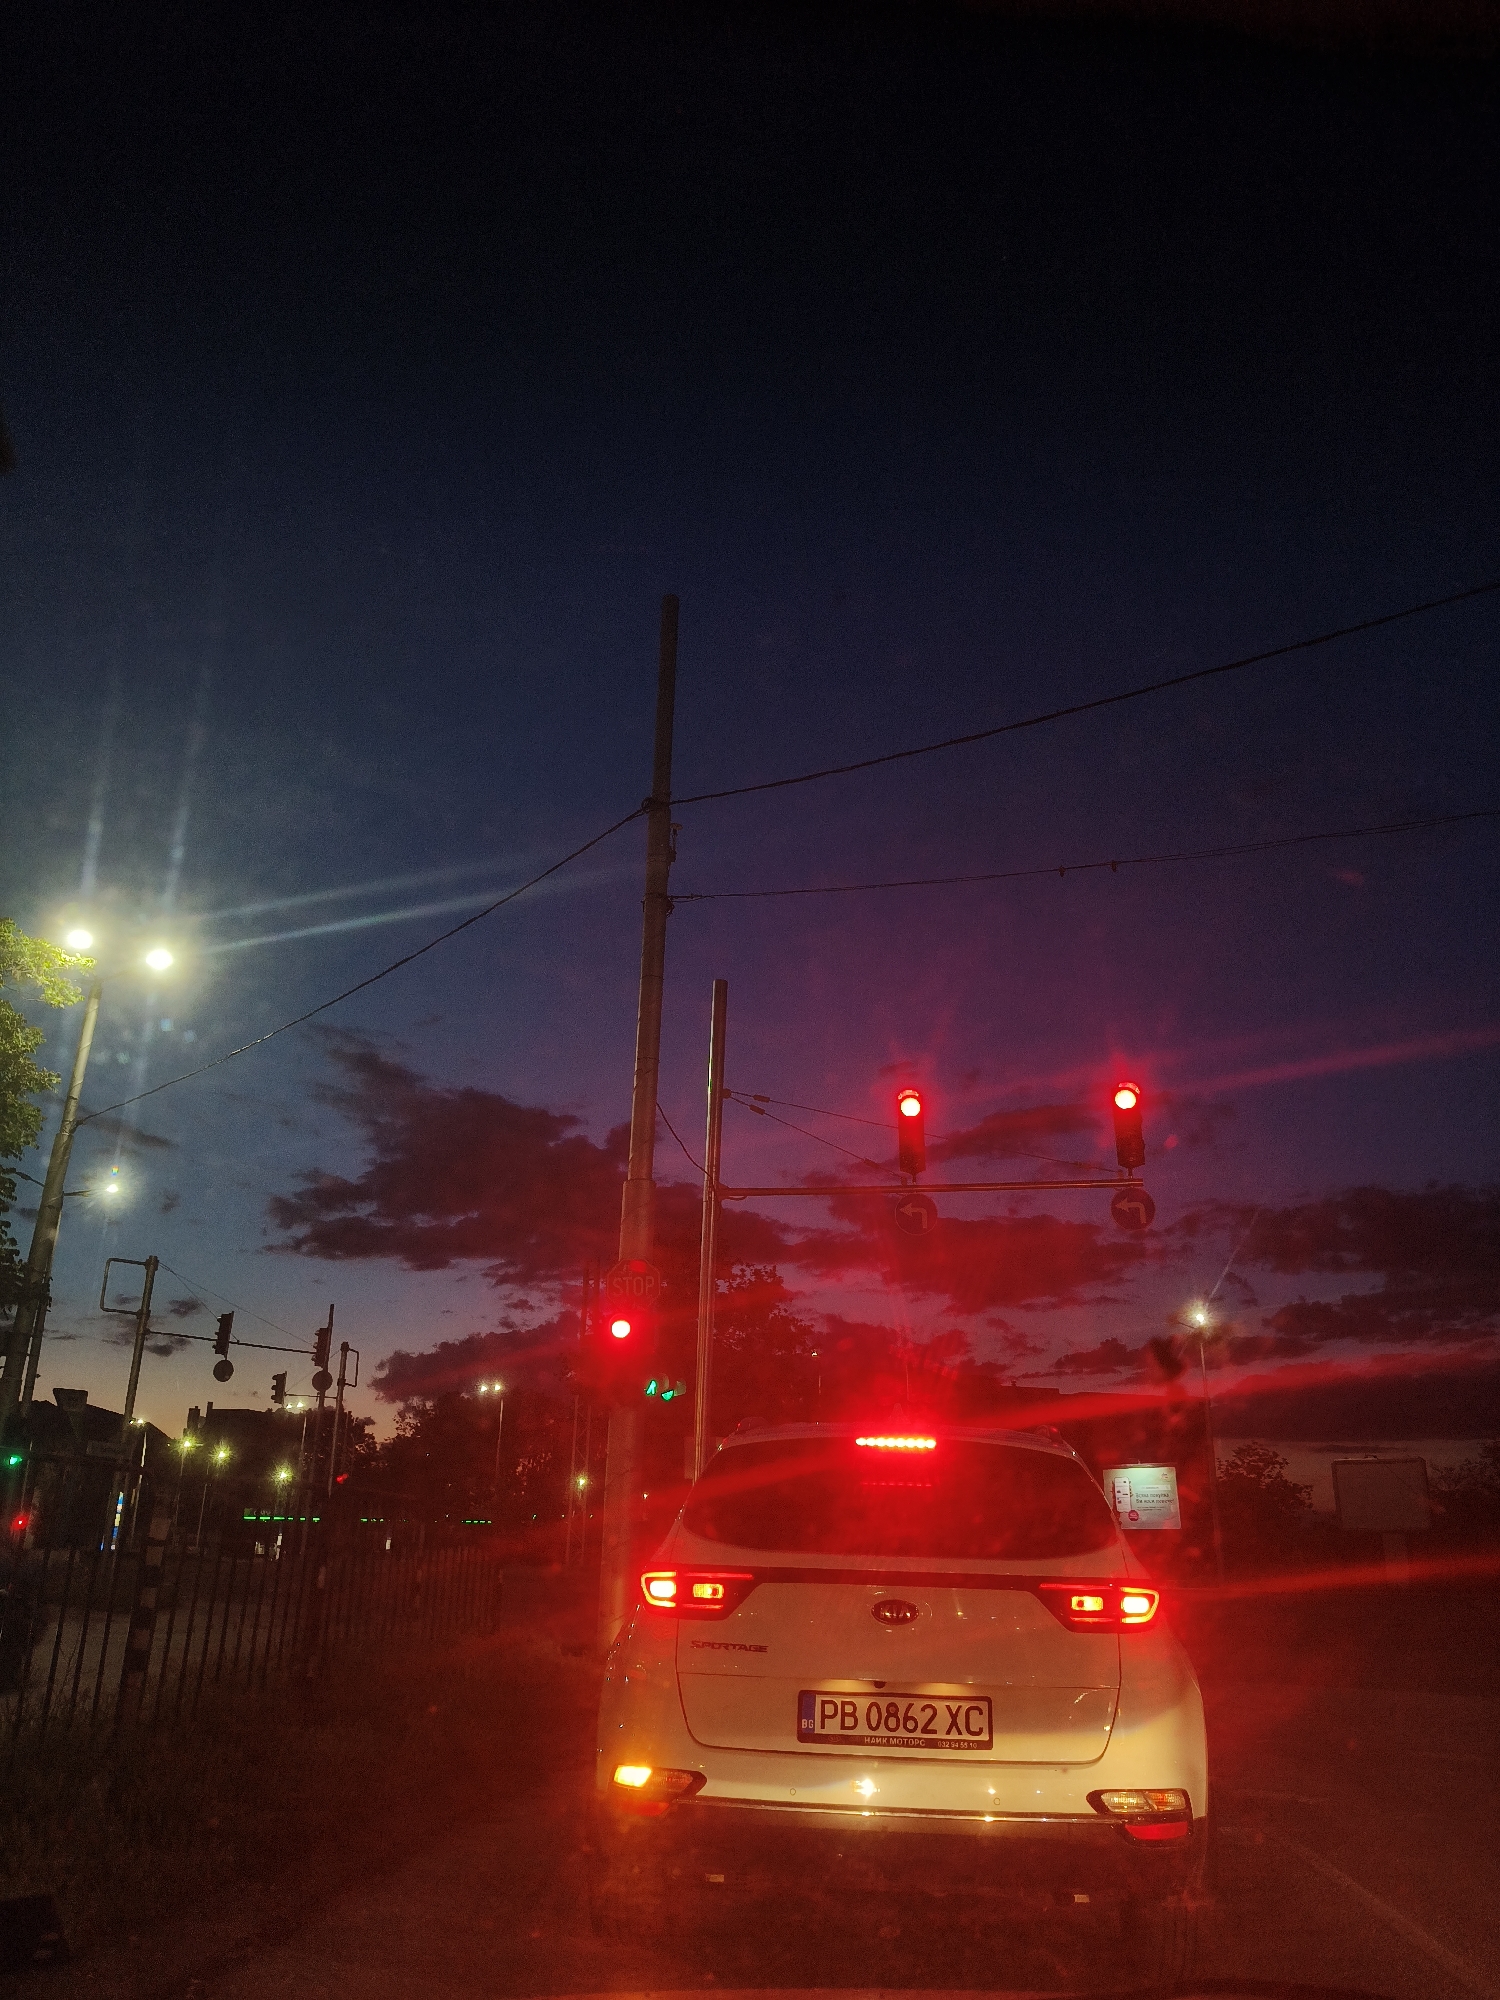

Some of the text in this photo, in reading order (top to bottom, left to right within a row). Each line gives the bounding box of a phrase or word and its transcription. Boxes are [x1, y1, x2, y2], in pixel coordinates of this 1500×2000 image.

[612, 1275, 655, 1297] STOP
[879, 1604, 911, 1619] KIA
[690, 1639, 769, 1653] SPORTAGE
[801, 1700, 984, 1736] BG PB 0862 XC
[890, 1737, 926, 1747] МОТОРС
